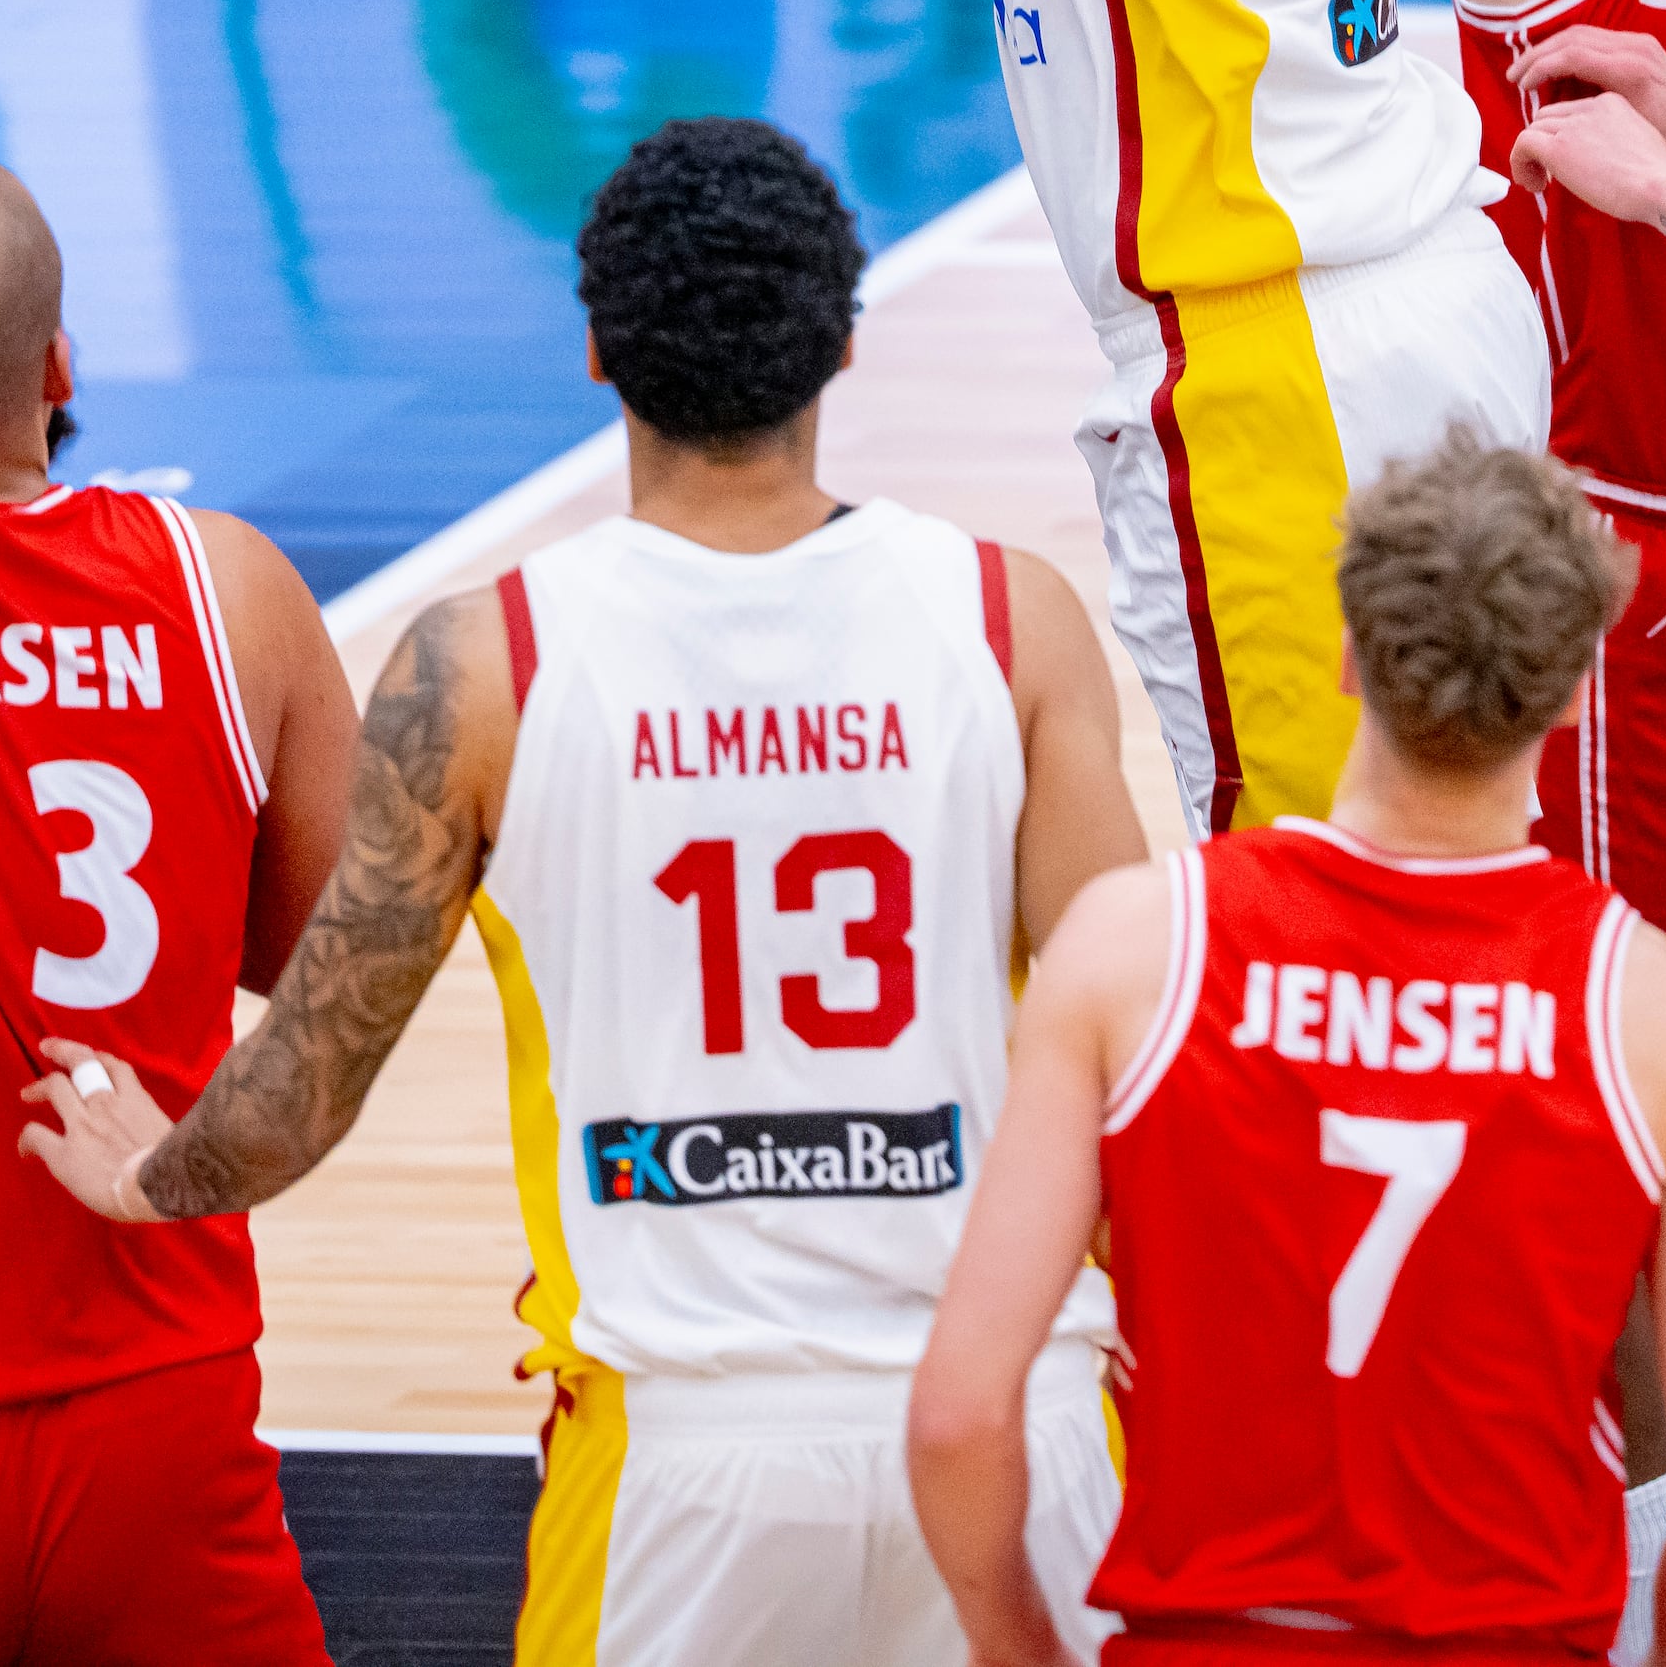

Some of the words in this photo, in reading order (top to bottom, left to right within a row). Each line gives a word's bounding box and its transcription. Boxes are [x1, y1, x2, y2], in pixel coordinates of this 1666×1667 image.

[633, 701, 910, 779] ALMANSA
[653, 829, 916, 1056] 13
[1231, 960, 1555, 1079] JENSEN
[1319, 1108, 1467, 1378] 7
